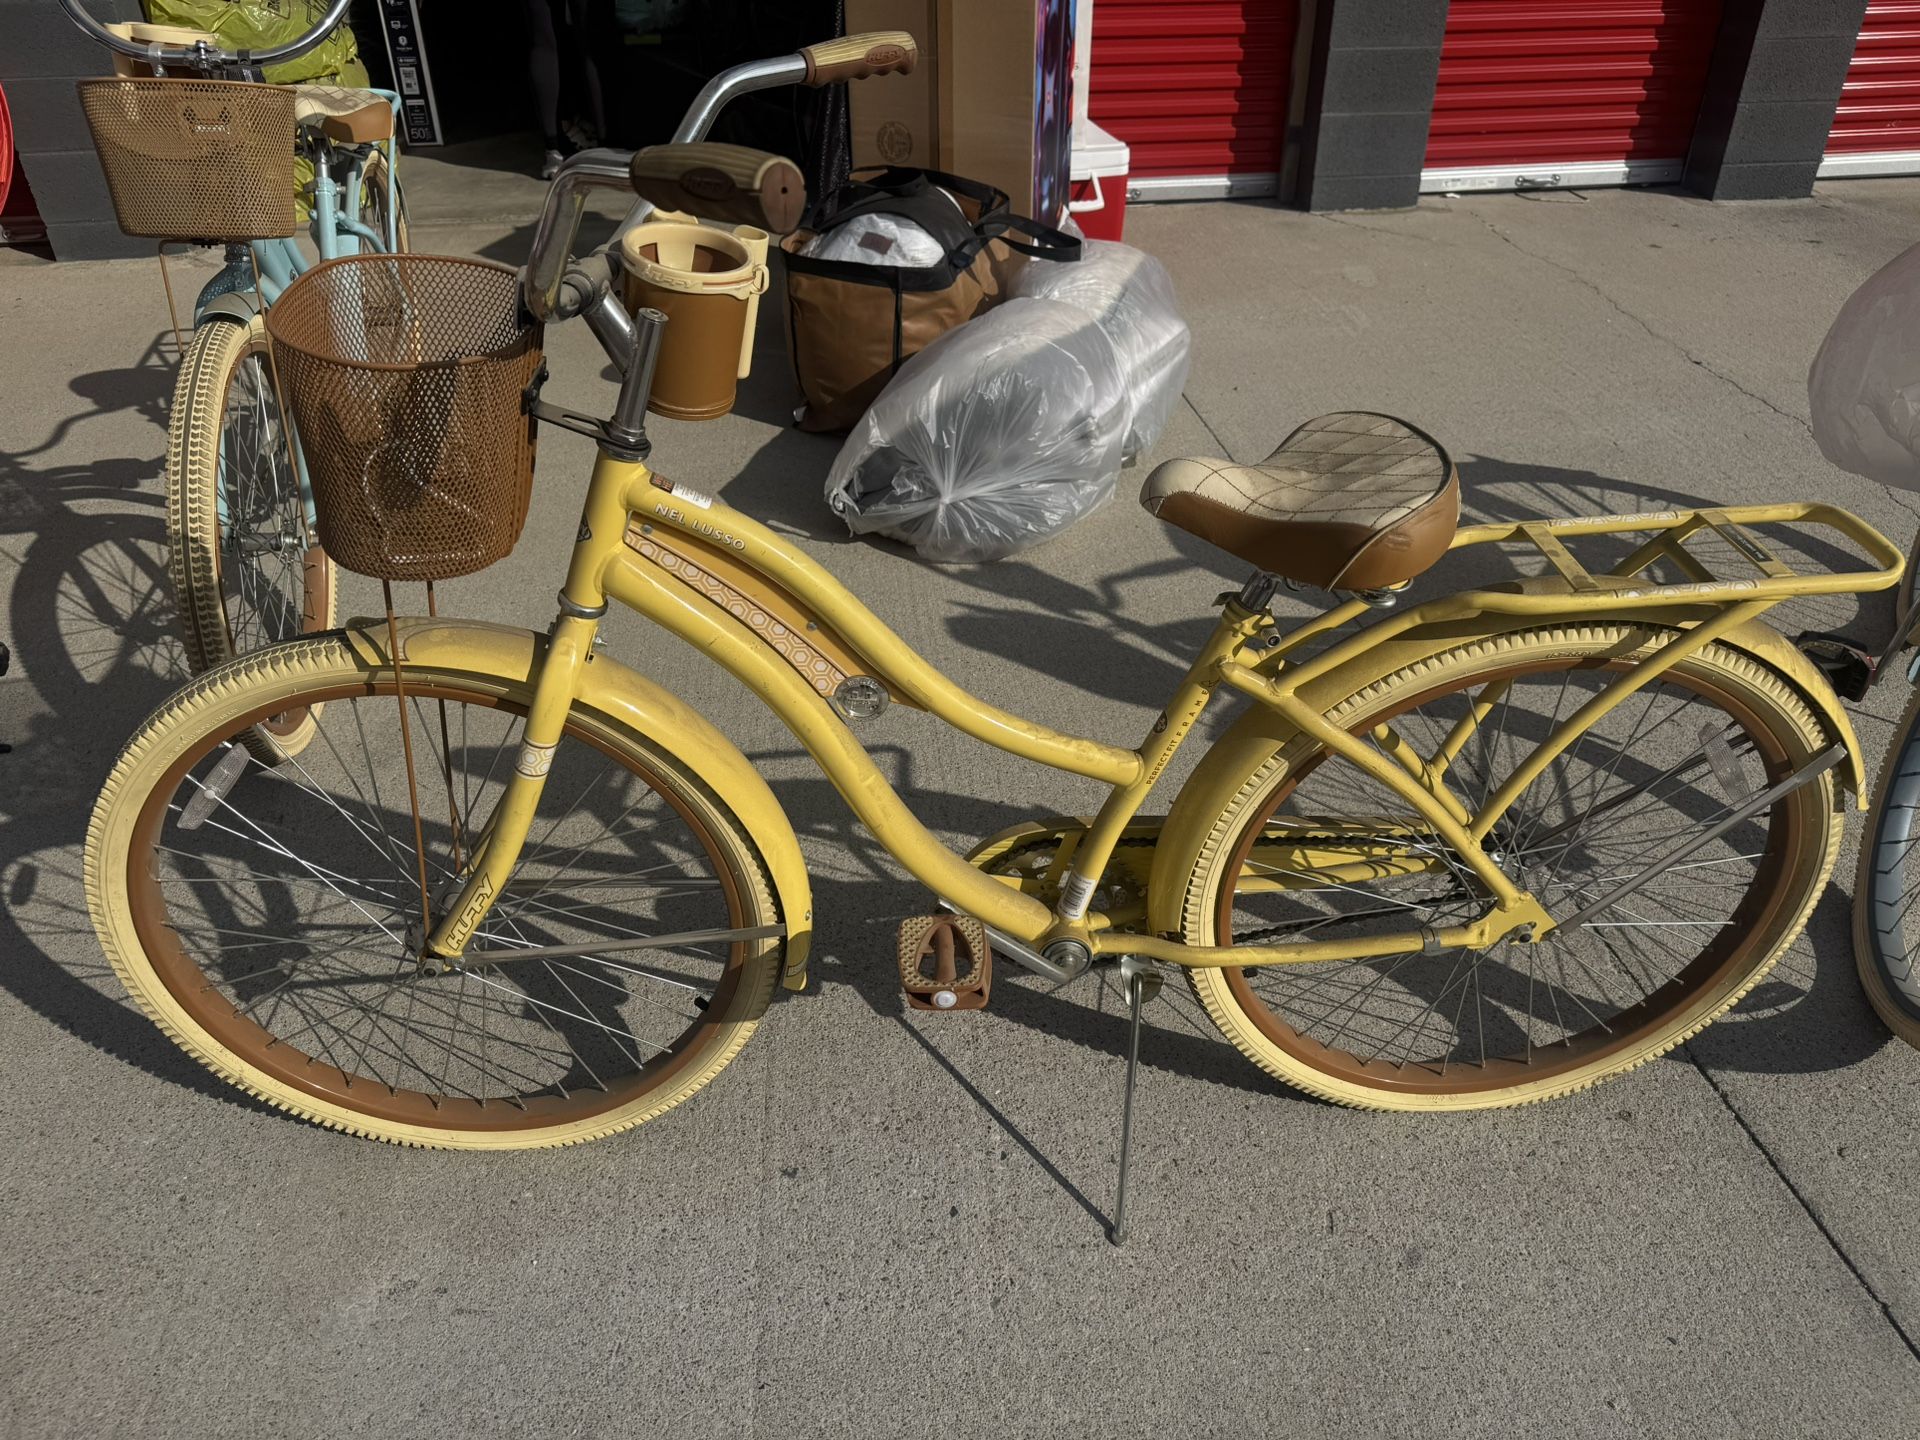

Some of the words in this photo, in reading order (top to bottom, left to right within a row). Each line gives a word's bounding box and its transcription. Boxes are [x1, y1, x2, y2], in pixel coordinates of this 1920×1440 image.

[655, 503, 685, 525] NEL
[691, 519, 745, 551] LUSSO
[1146, 753, 1169, 784] PERFECT
[1167, 740, 1178, 754] FIT
[1177, 690, 1208, 737] FRAME
[446, 872, 494, 951] HUFFY
